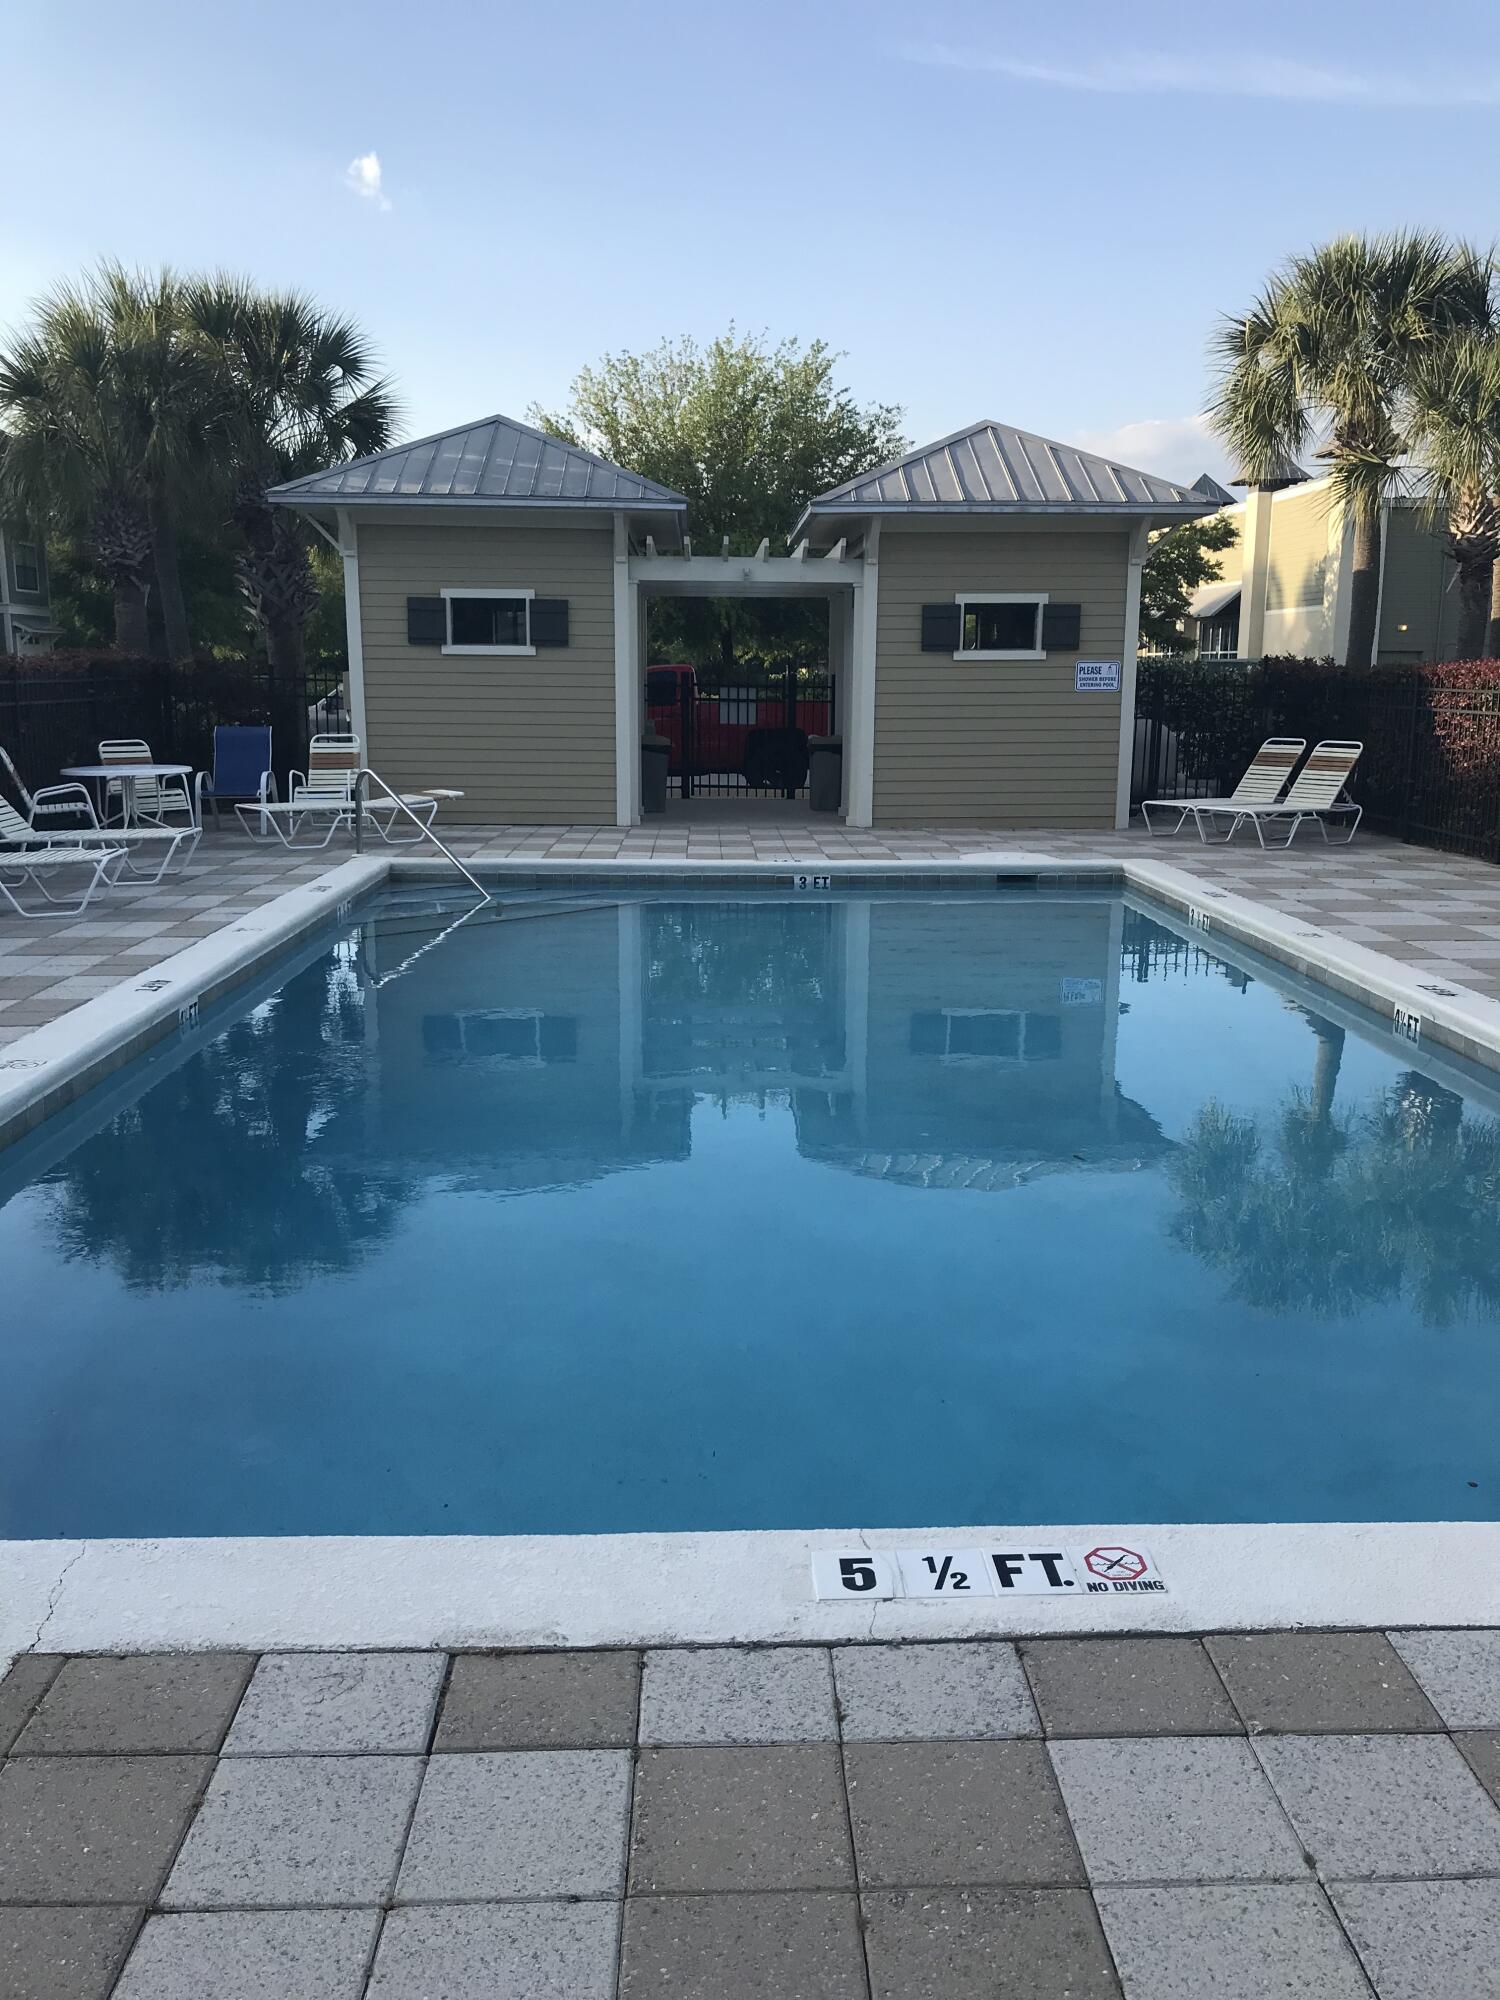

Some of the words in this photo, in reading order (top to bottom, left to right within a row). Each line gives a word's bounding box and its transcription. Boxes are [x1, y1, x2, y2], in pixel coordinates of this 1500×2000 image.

[1079, 666, 1102, 675] PLEASE
[839, 1557, 877, 1592] 5
[992, 1553, 1075, 1588] FT.
[1086, 1582, 1109, 1592] NO
[1112, 1580, 1165, 1592] DIVING
